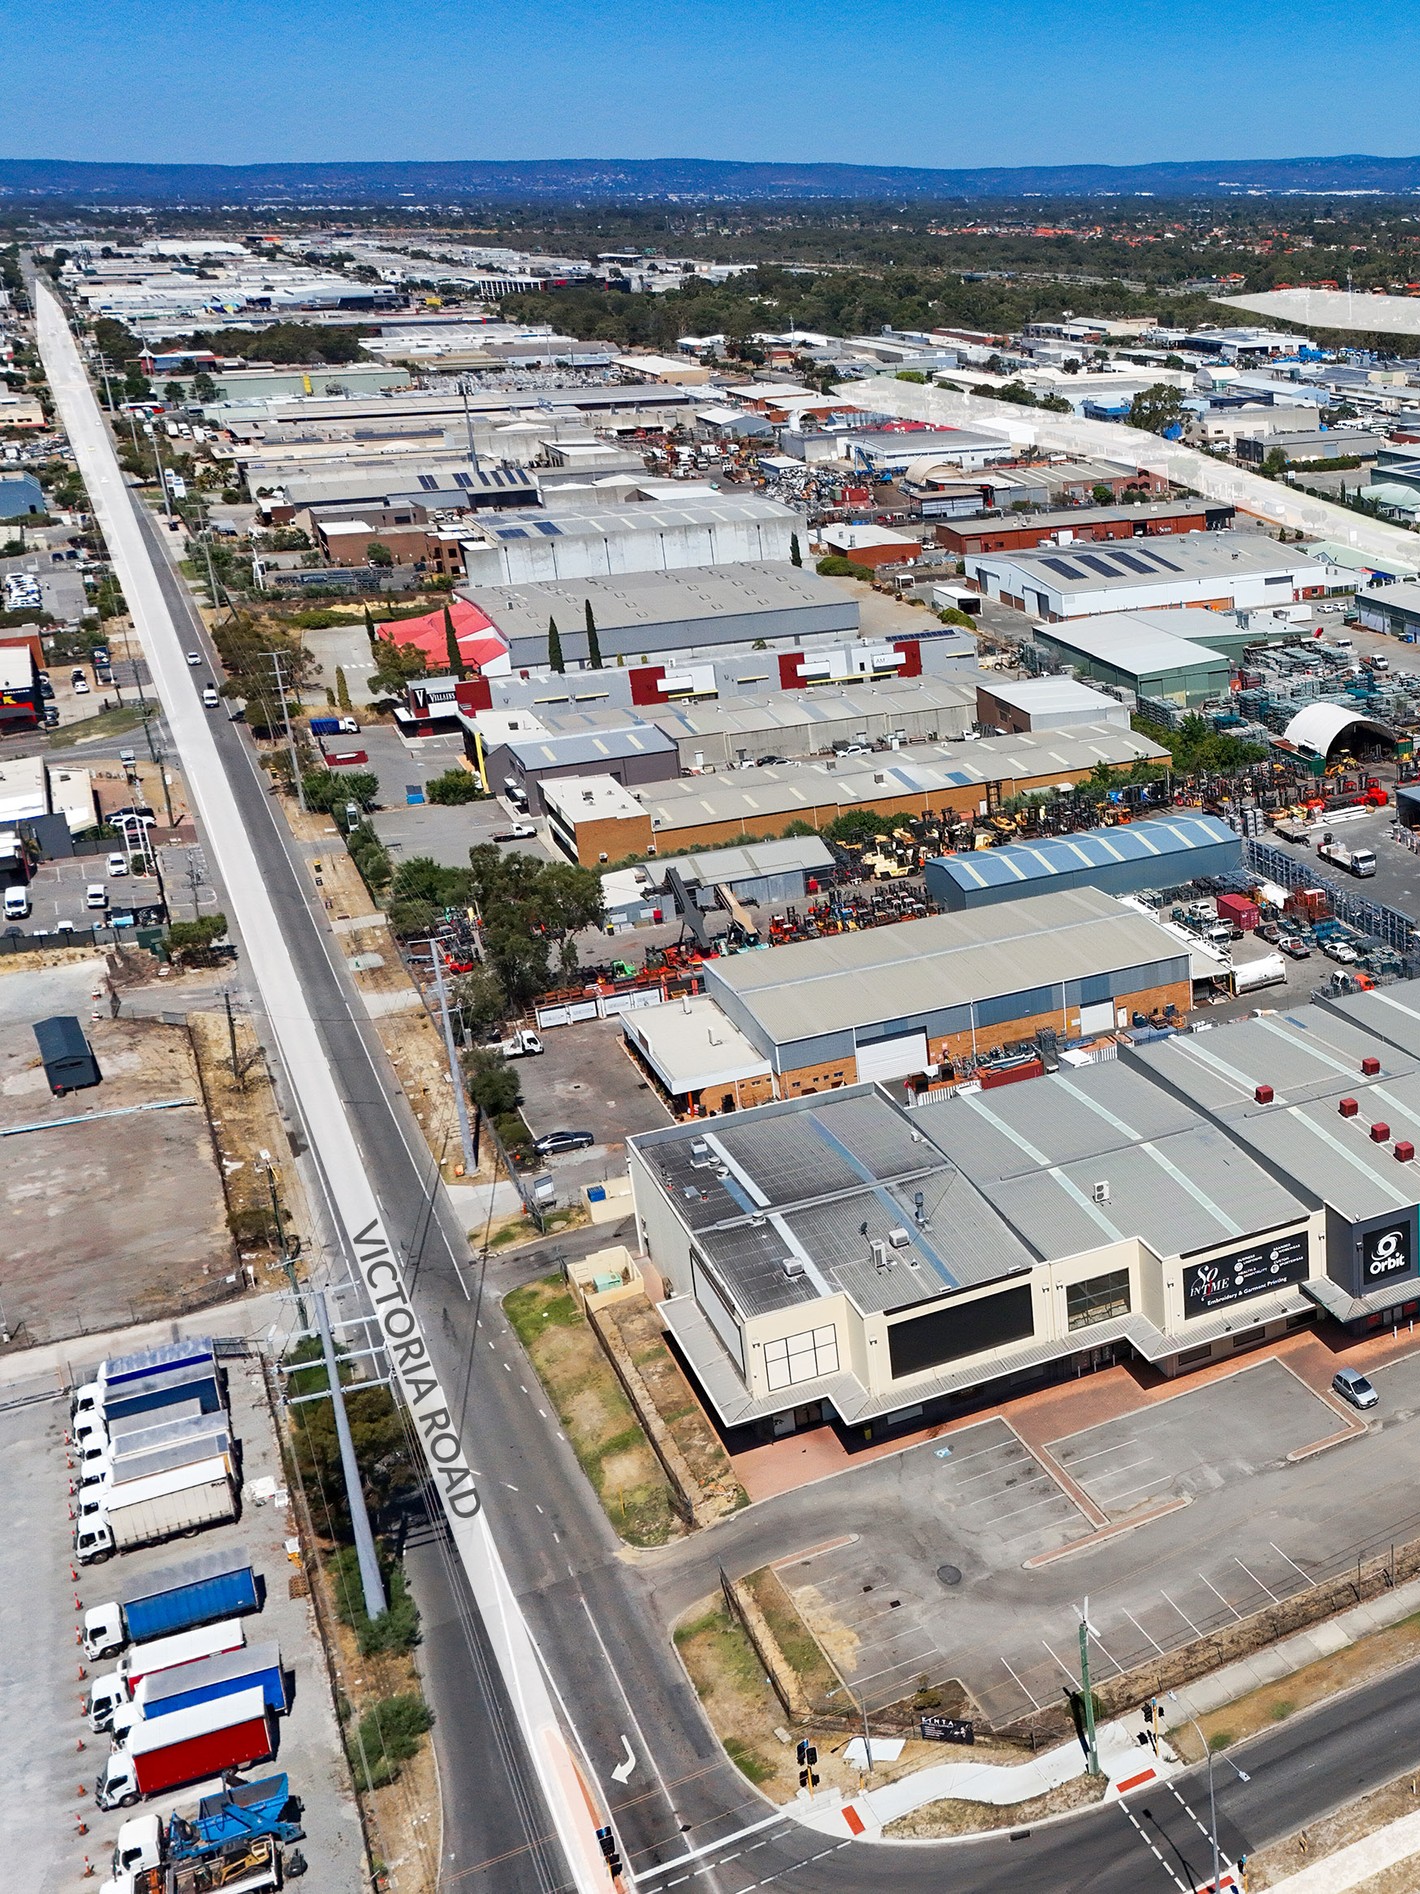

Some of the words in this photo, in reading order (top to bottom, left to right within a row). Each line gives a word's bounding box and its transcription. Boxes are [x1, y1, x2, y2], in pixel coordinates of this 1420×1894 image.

[1369, 1252, 1406, 1275] Orbit
[1207, 1293, 1238, 1306] Embroidery
[1244, 1283, 1267, 1295] Garment
[1267, 1277, 1287, 1288] Printing
